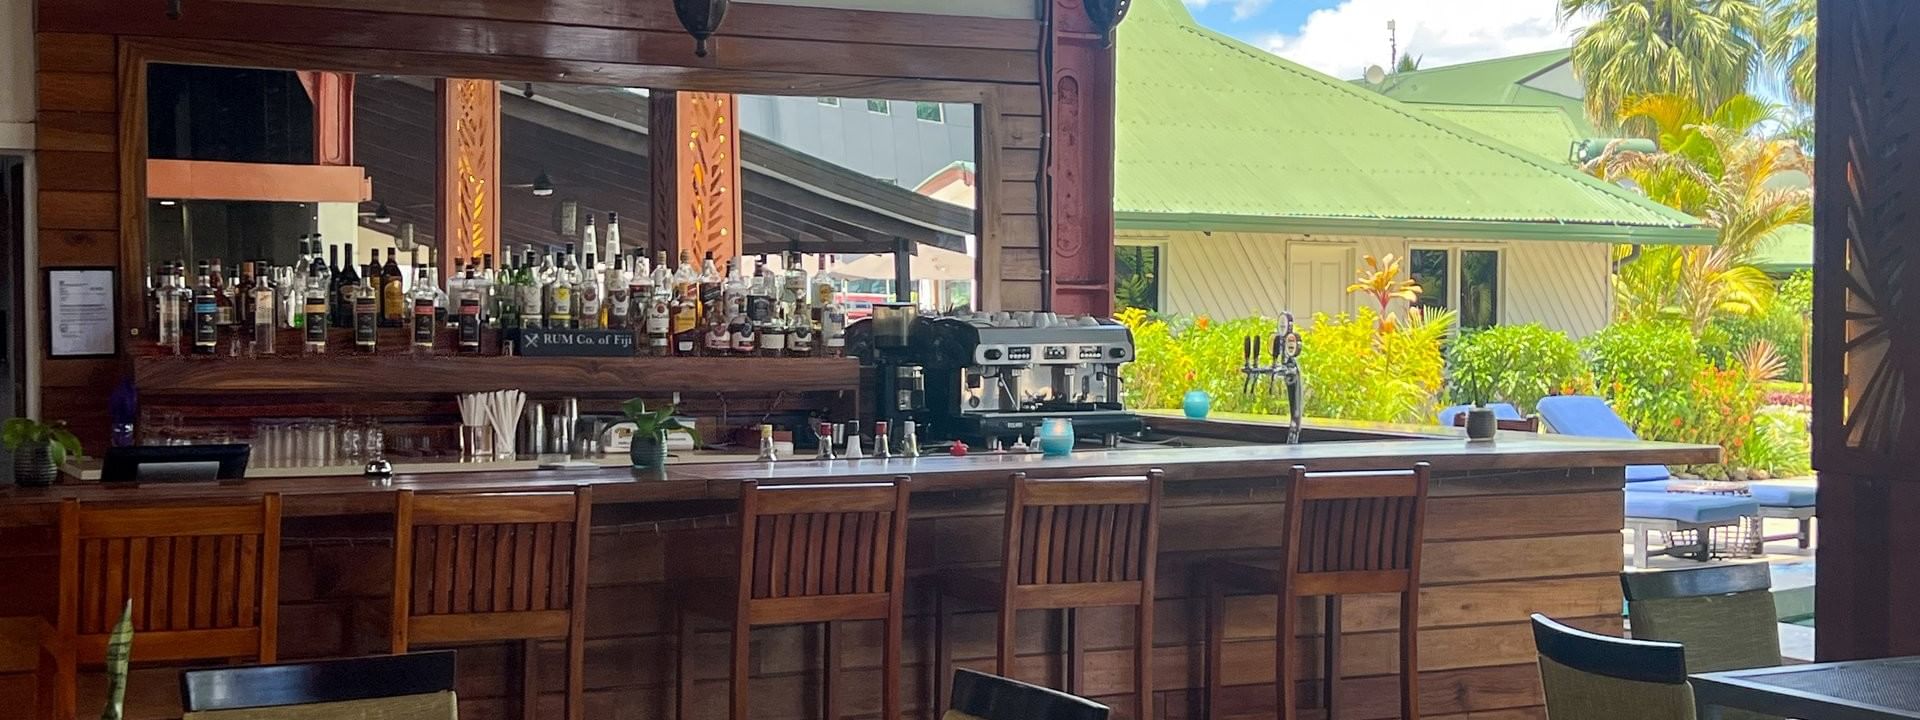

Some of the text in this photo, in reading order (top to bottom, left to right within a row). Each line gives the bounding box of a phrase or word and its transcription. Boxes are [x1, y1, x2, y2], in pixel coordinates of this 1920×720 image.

[543, 333, 632, 348] RUM Co. of Fiji
